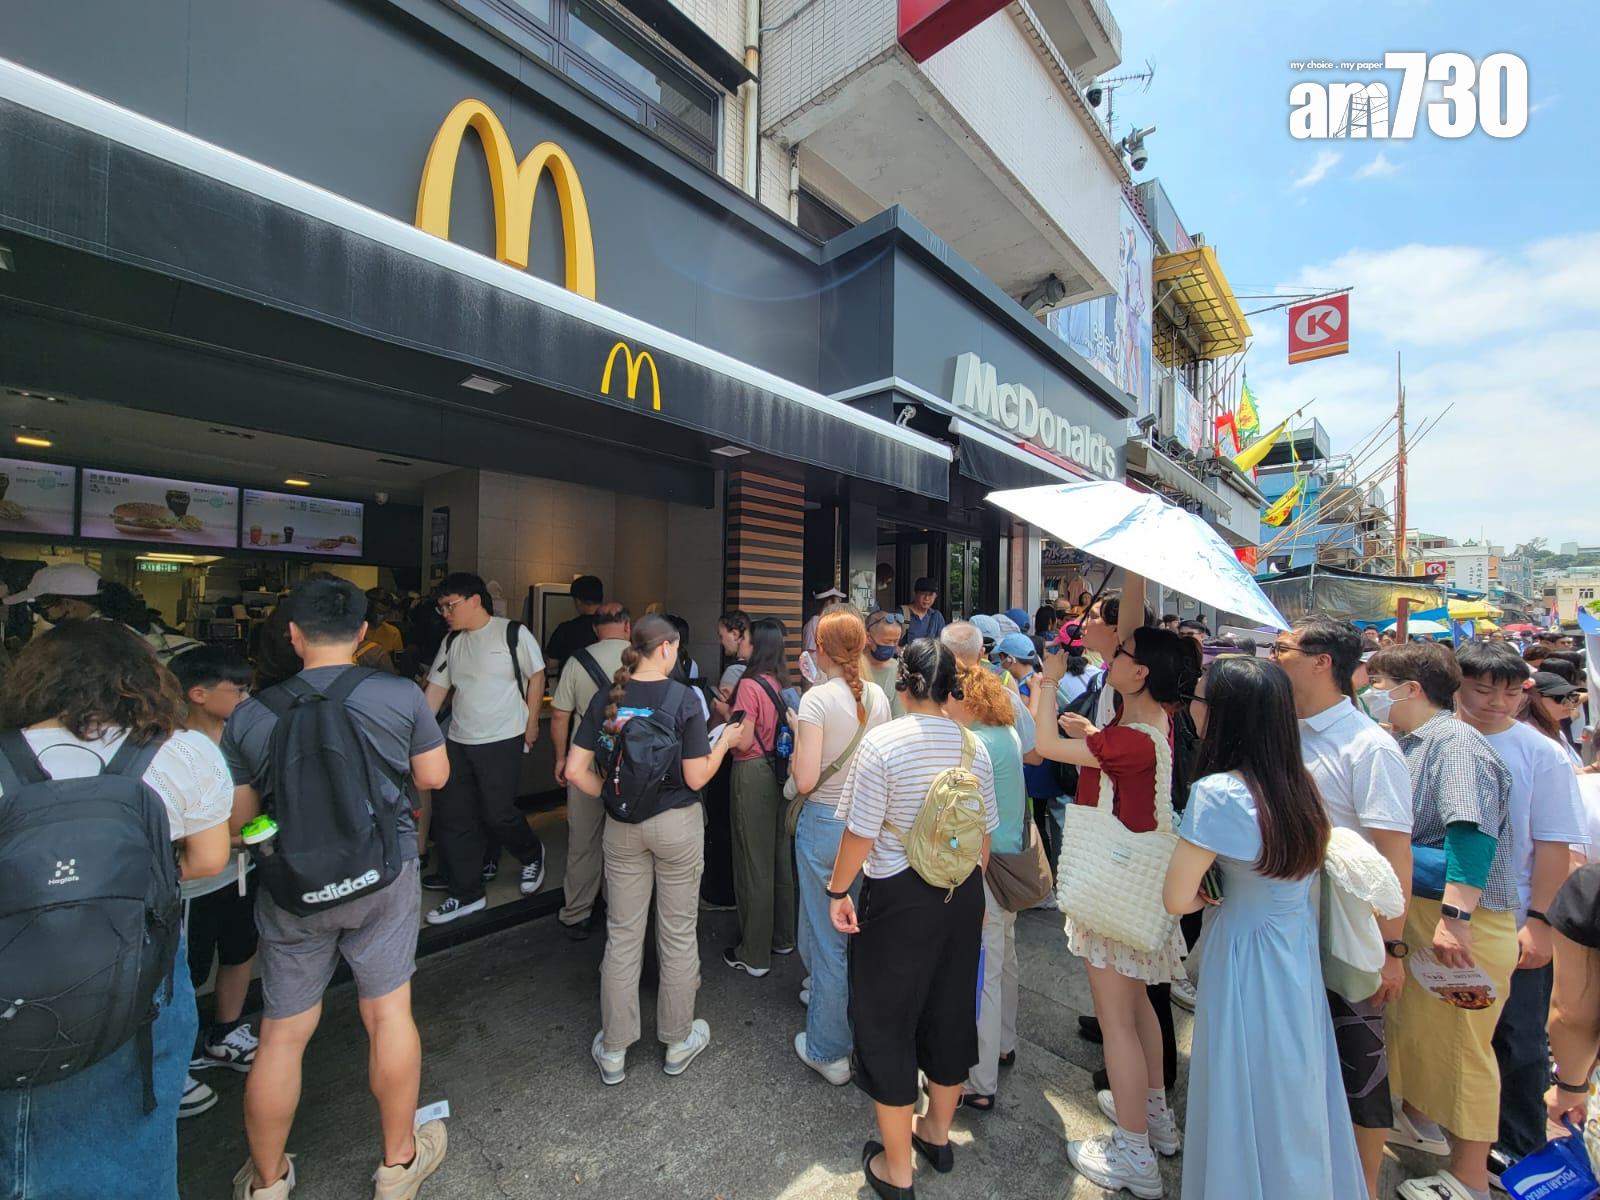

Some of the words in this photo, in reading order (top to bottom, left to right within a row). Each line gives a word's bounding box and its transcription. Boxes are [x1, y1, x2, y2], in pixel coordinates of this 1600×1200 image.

[1304, 307, 1341, 339] K
[952, 352, 1117, 480] McDonald's
[302, 869, 380, 903] adidas
